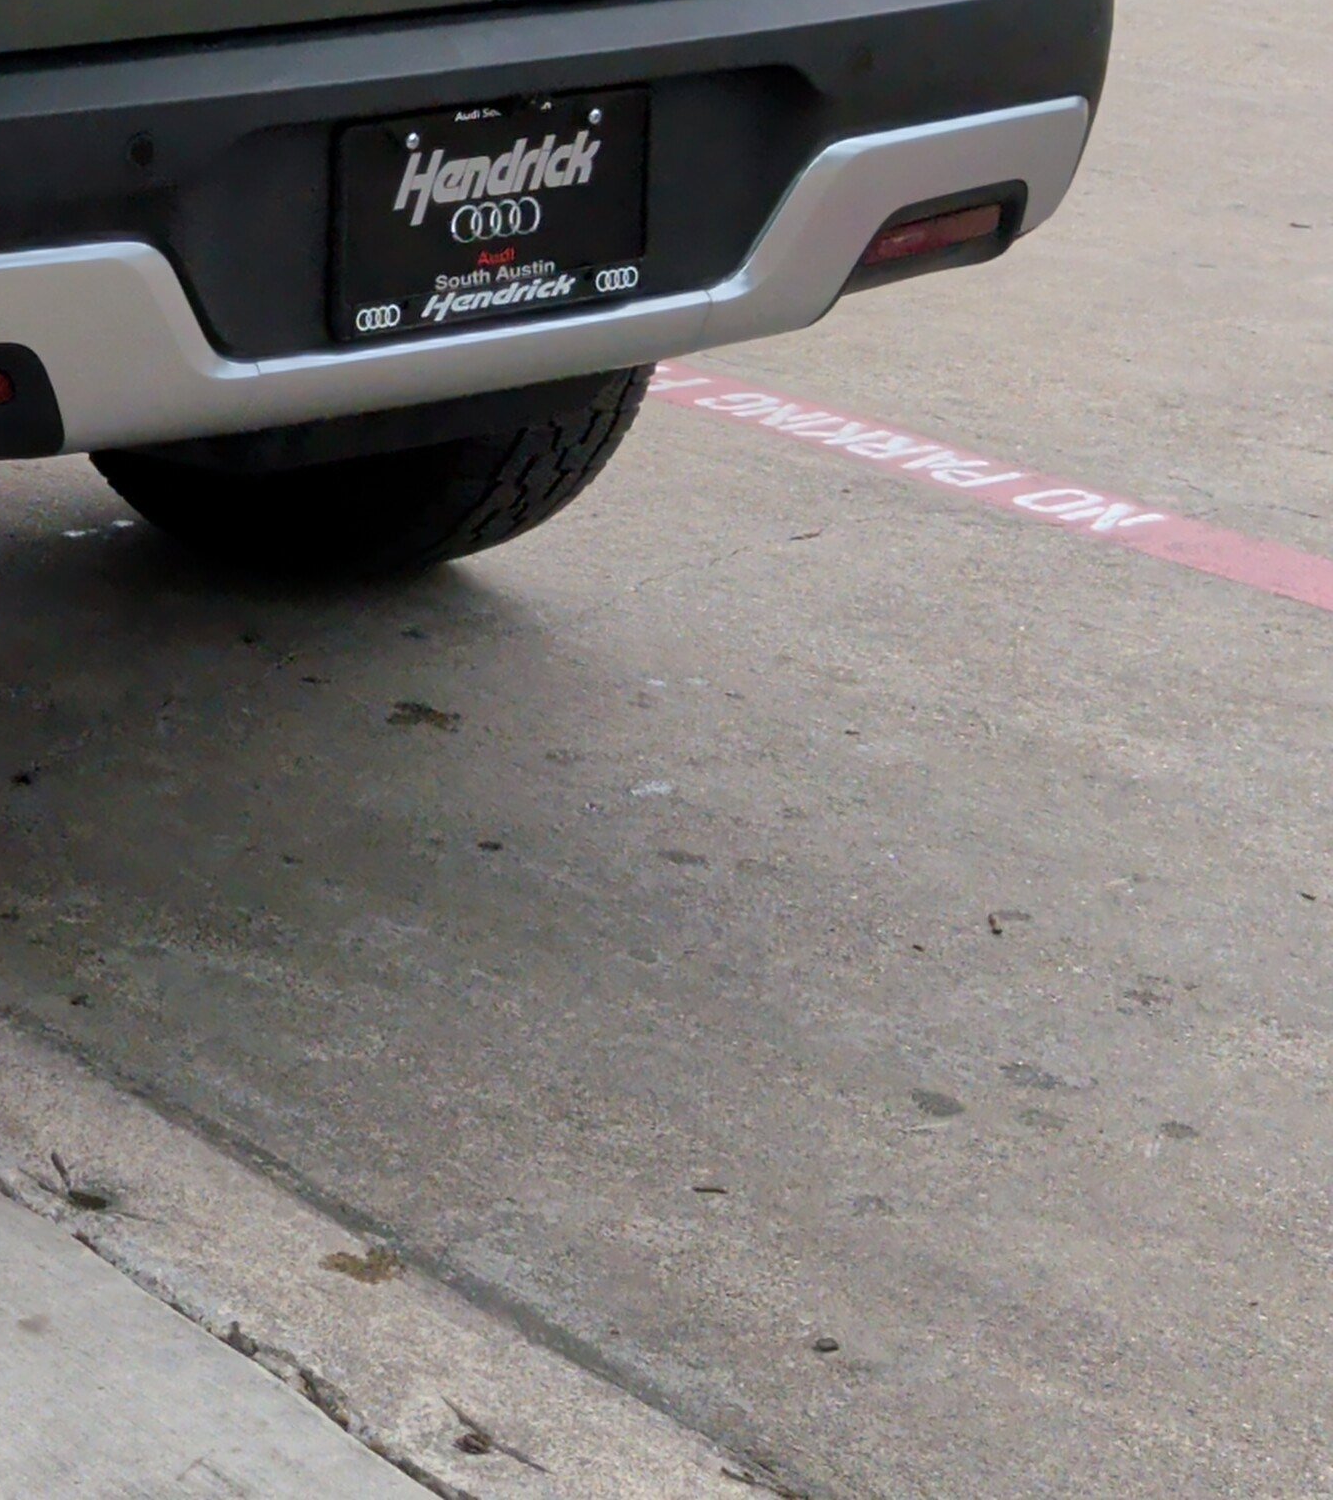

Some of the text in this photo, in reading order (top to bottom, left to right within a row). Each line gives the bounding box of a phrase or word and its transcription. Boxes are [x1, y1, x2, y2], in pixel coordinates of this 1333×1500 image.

[392, 129, 602, 227] Hendrick
[435, 260, 556, 291] South Austin
[477, 247, 516, 266] Audi
[421, 274, 576, 322] Hendrick
[694, 392, 1167, 533] NO PARKING
